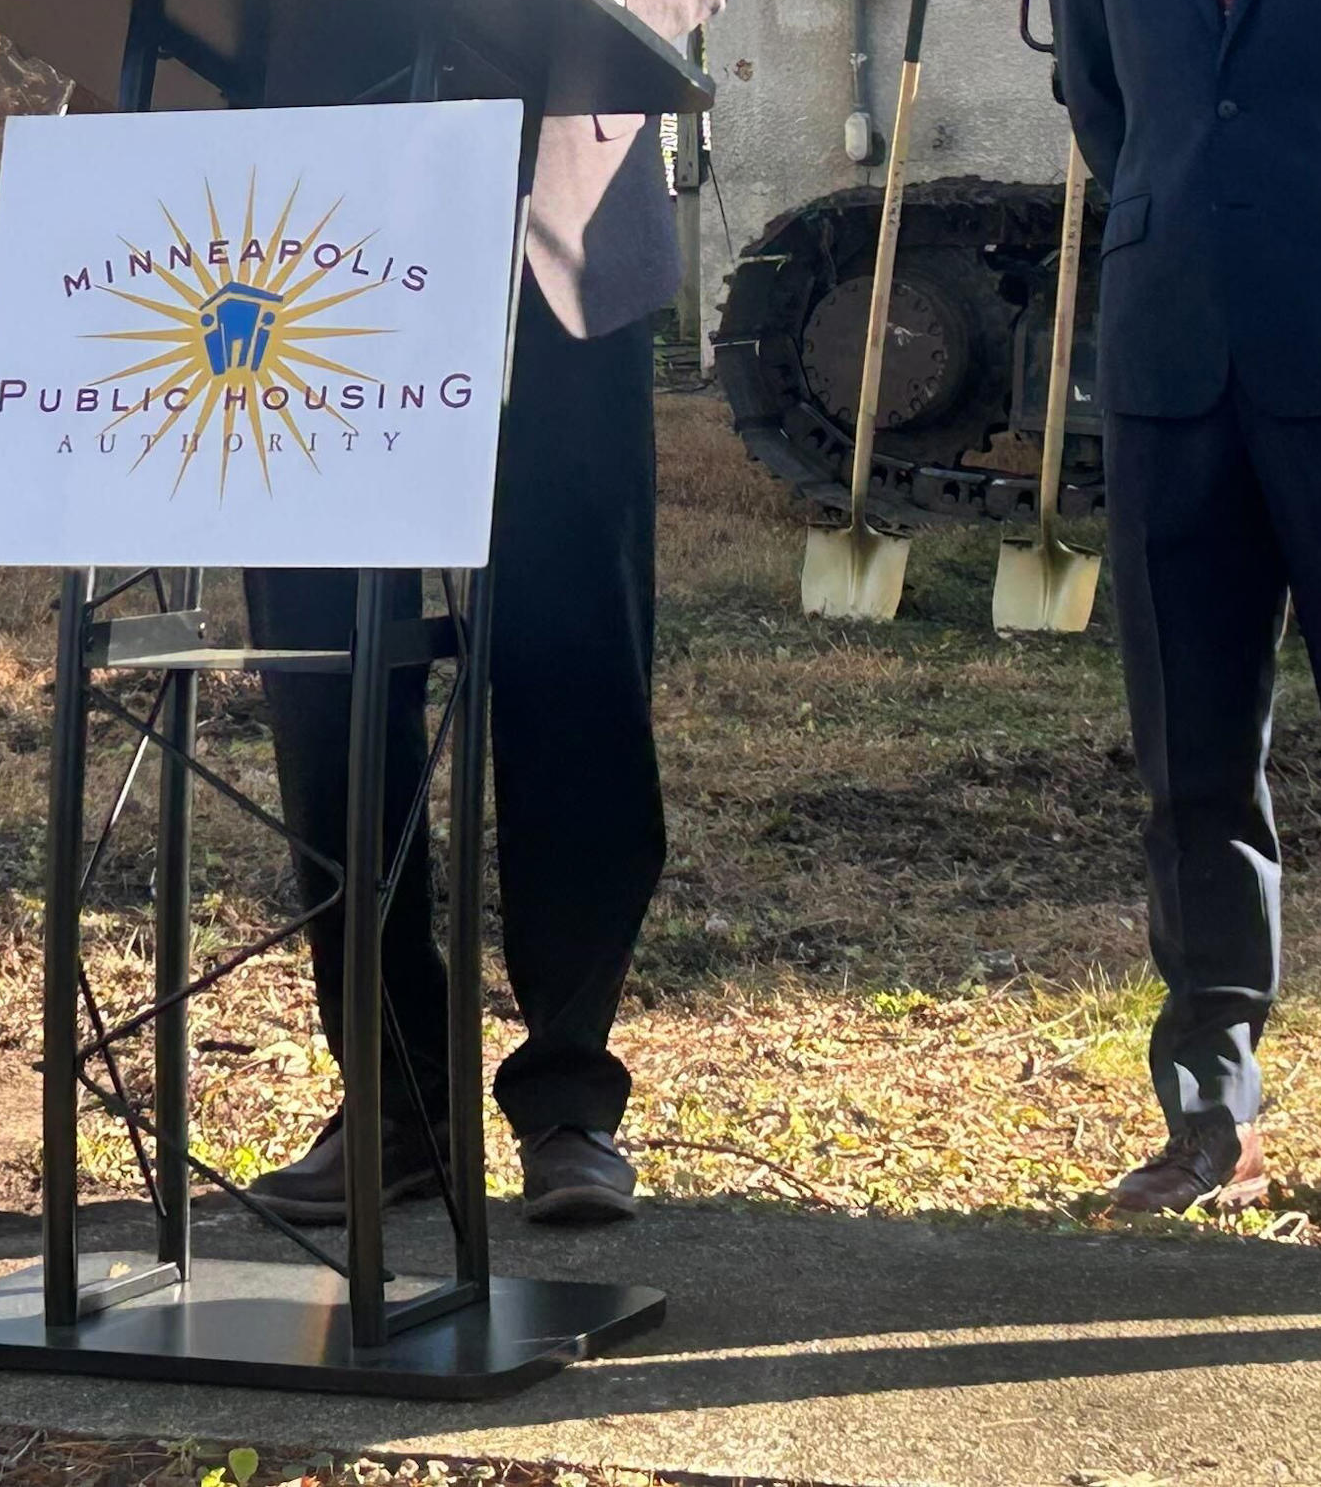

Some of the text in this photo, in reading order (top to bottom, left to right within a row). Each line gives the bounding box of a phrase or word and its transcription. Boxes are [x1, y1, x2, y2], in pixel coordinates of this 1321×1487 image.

[63, 238, 429, 297] MINNEAPOLIS
[223, 372, 473, 410] HOUSING
[56, 430, 402, 455] AUTHORITY
